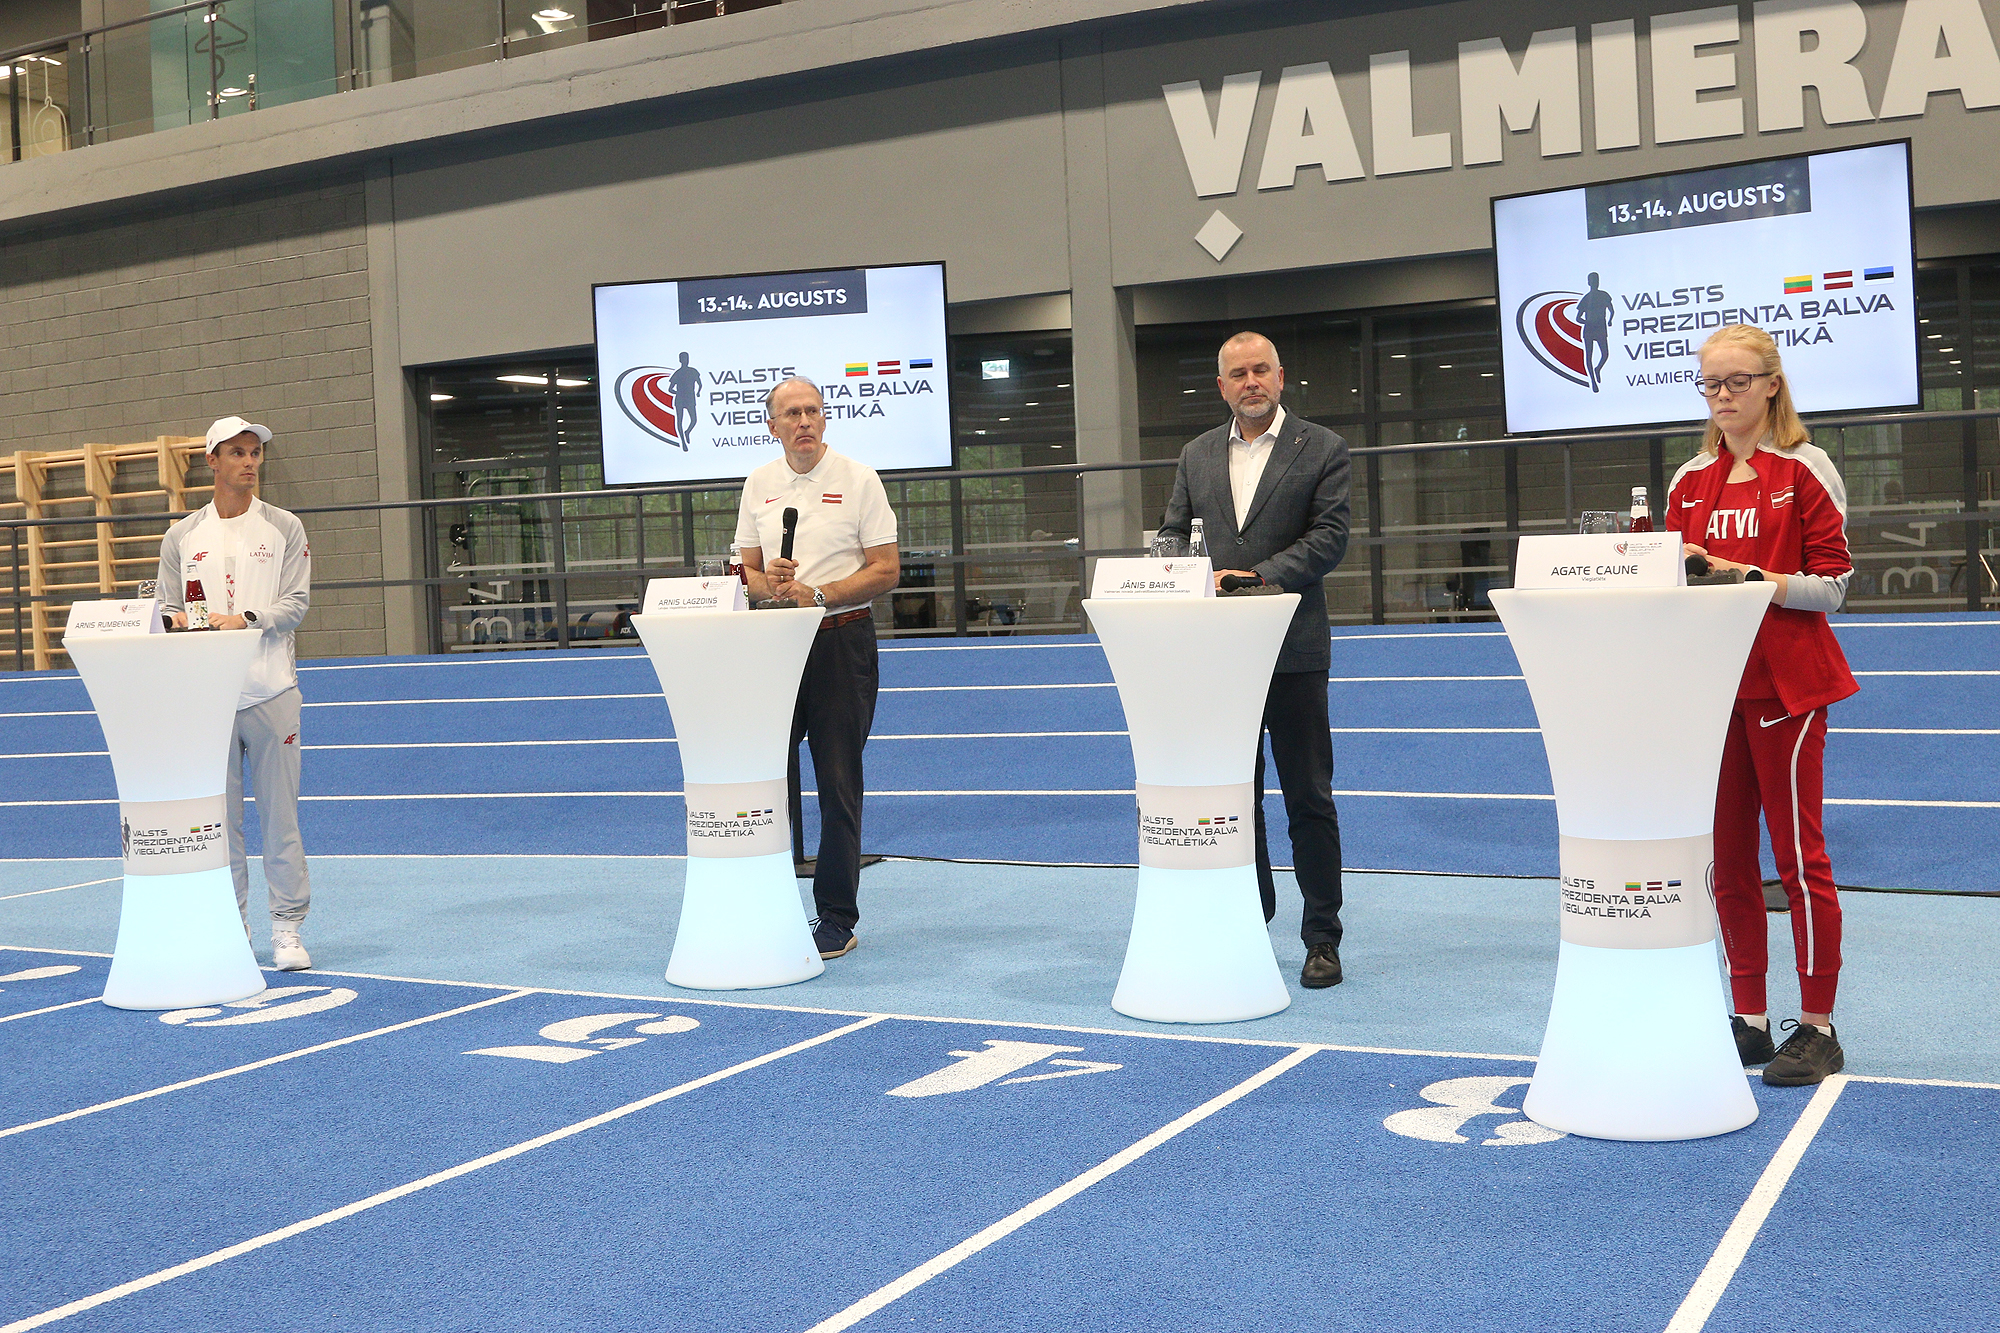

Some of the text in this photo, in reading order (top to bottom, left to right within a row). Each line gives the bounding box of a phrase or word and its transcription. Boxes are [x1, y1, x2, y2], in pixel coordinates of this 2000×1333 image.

[1162, 0, 2000, 197] VALMIERA
[1608, 183, 1786, 224] 13.-14. AUGUSTS
[698, 288, 848, 312] 13.-14. AUGUSTS
[1621, 284, 1725, 311] VALSTS
[1622, 293, 1896, 337] PREZIDENTA BALVA
[1623, 321, 1834, 361] VIEGLTIKĀ
[708, 366, 796, 385] VALSTS
[710, 379, 934, 406] PREZTA BALVA
[712, 434, 781, 448] VALMIERA
[1704, 508, 1760, 540] ATVI
[1551, 565, 1638, 576] AGATE CAUNE
[1120, 580, 1176, 589] JĀNIS BAIKS
[657, 598, 681, 606] ARNIS
[75, 619, 141, 629] ARNIS RUMBENIEKS
[689, 811, 715, 819] VALSTS
[1142, 815, 1174, 825] VALSTS
[689, 818, 774, 829] PREZIDENTA BALVA
[1142, 825, 1239, 836] PREZIDENTA BALVA
[132, 829, 168, 837] VALSTS
[133, 832, 222, 846] PREZIDENTA BALVA
[1142, 835, 1218, 847] VIEGLATLĒTIKĀ
[133, 843, 208, 856] VIEGLATLĒTIKĀ
[1562, 875, 1595, 889] VALSTS
[1562, 888, 1682, 905] PREZIDENTA BALVA
[1562, 901, 1652, 919] VIEGLATLĒTIKĀ
